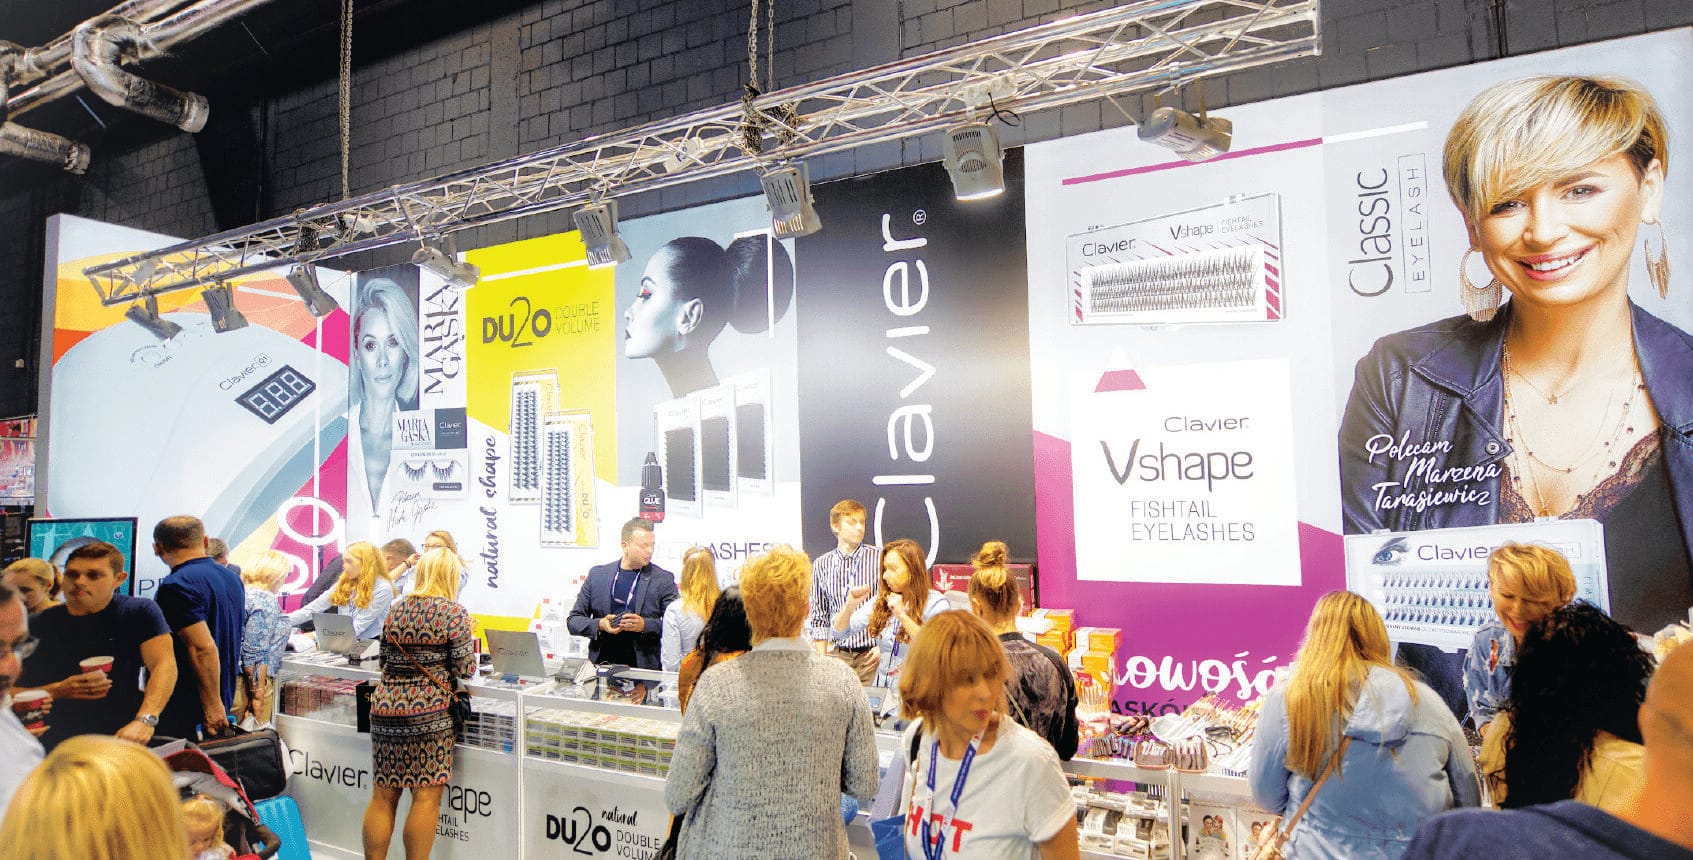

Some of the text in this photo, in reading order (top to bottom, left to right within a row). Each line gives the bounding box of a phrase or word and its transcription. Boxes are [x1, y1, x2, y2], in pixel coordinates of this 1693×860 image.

[1170, 223, 1214, 241] Vshape
[1349, 168, 1394, 297] Classic
[1407, 168, 1425, 282] EYELASH
[1082, 238, 1137, 257] Clavier
[555, 301, 599, 320] DOUBLE
[424, 284, 450, 395] MARIA
[555, 318, 600, 335] VOLUME
[219, 362, 257, 391] Clavier
[1164, 416, 1250, 432] Clavier
[1365, 429, 1453, 464] Polecam
[1100, 438, 1254, 493] Vshape
[1403, 456, 1503, 489] Marzena
[1131, 499, 1218, 518] FISHTAIL
[1371, 481, 1491, 513] Tarasiewicz
[478, 434, 501, 590] natural shape
[1132, 522, 1255, 541] EYELASHES
[288, 748, 369, 788] Clavier
[601, 806, 638, 827] natural
[616, 829, 661, 851] DOUBLE
